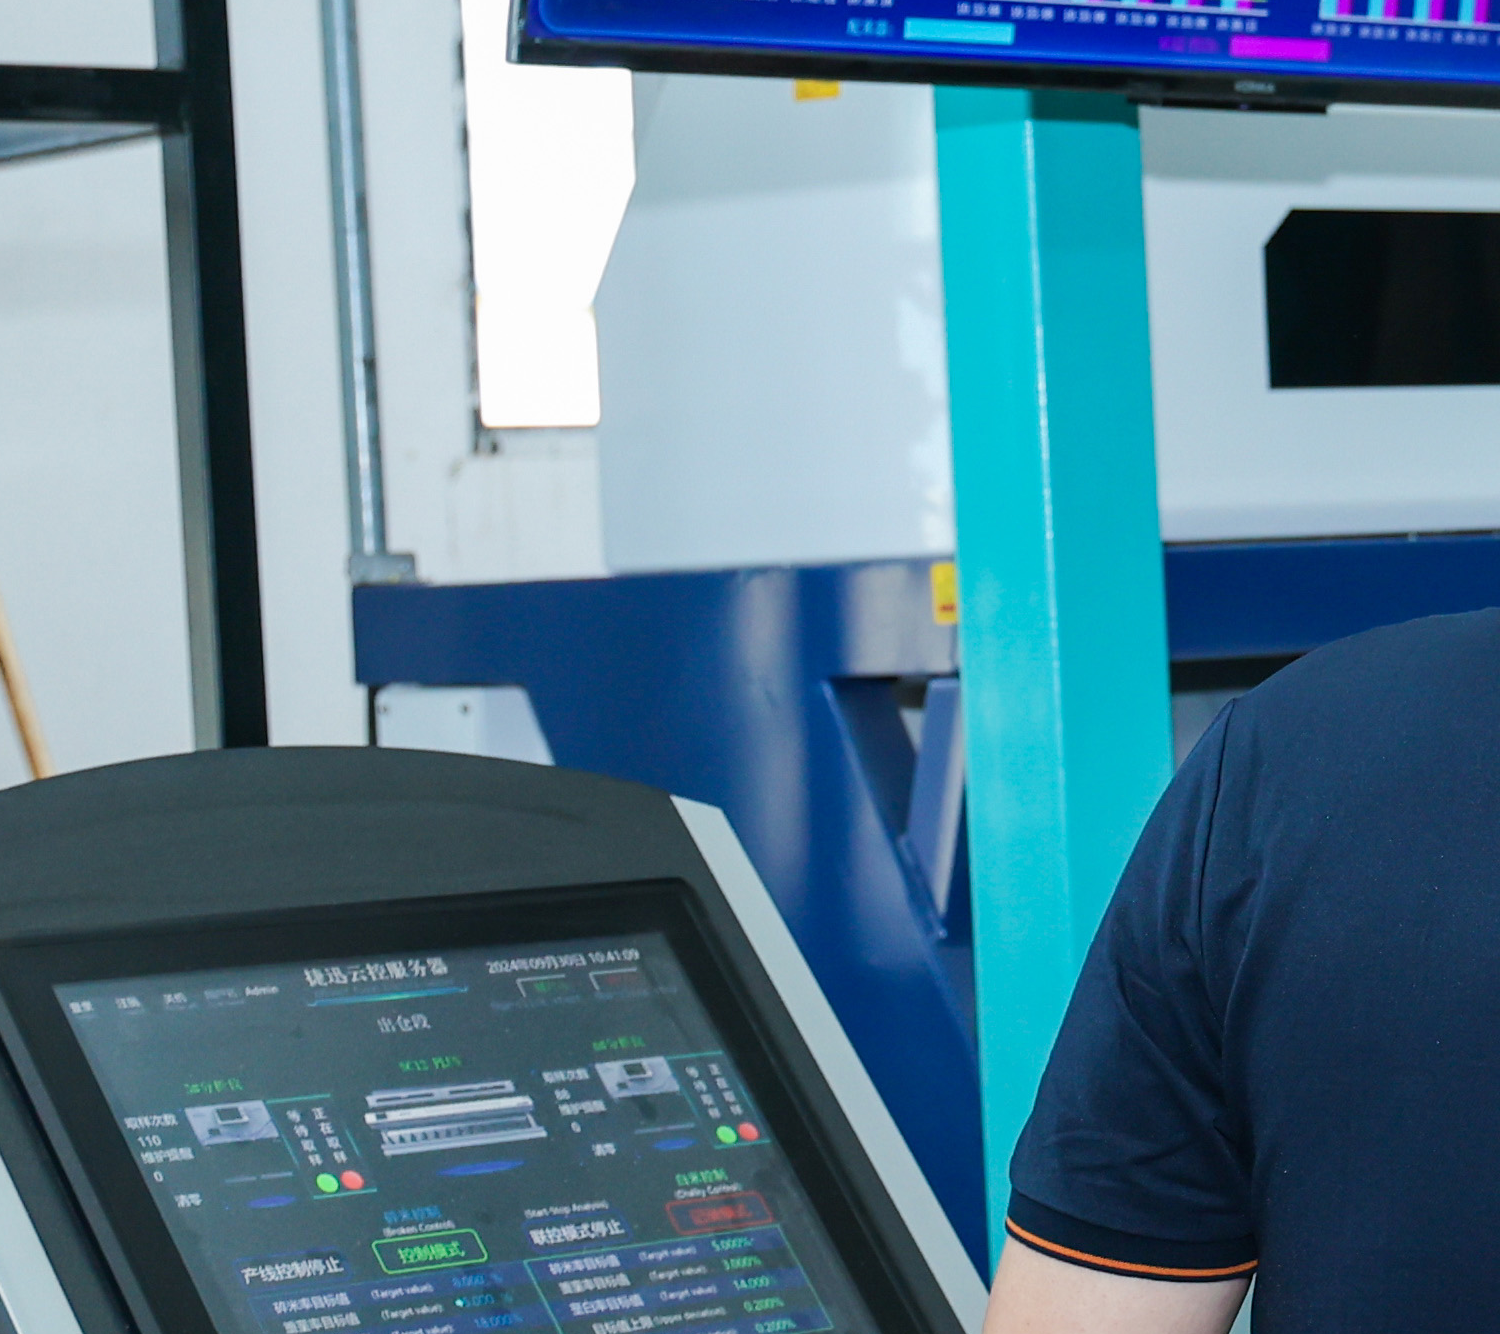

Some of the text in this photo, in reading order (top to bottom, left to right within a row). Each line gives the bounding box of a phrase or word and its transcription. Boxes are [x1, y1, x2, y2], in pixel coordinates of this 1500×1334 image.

[304, 957, 448, 988] 捷迅云控服务器
[377, 1013, 431, 1035] 出仓段
[137, 1135, 162, 1148] 110
[153, 1170, 163, 1182] 0
[529, 1219, 625, 1246] 联控模式停止
[397, 1241, 466, 1264] 控制模式
[240, 1256, 345, 1284] 产线控制停止
[272, 1292, 351, 1314] 碎米率目标值
[371, 1286, 404, 1300] (Target
[381, 1307, 414, 1321] (Target
[743, 1297, 785, 1312] 0.200%
